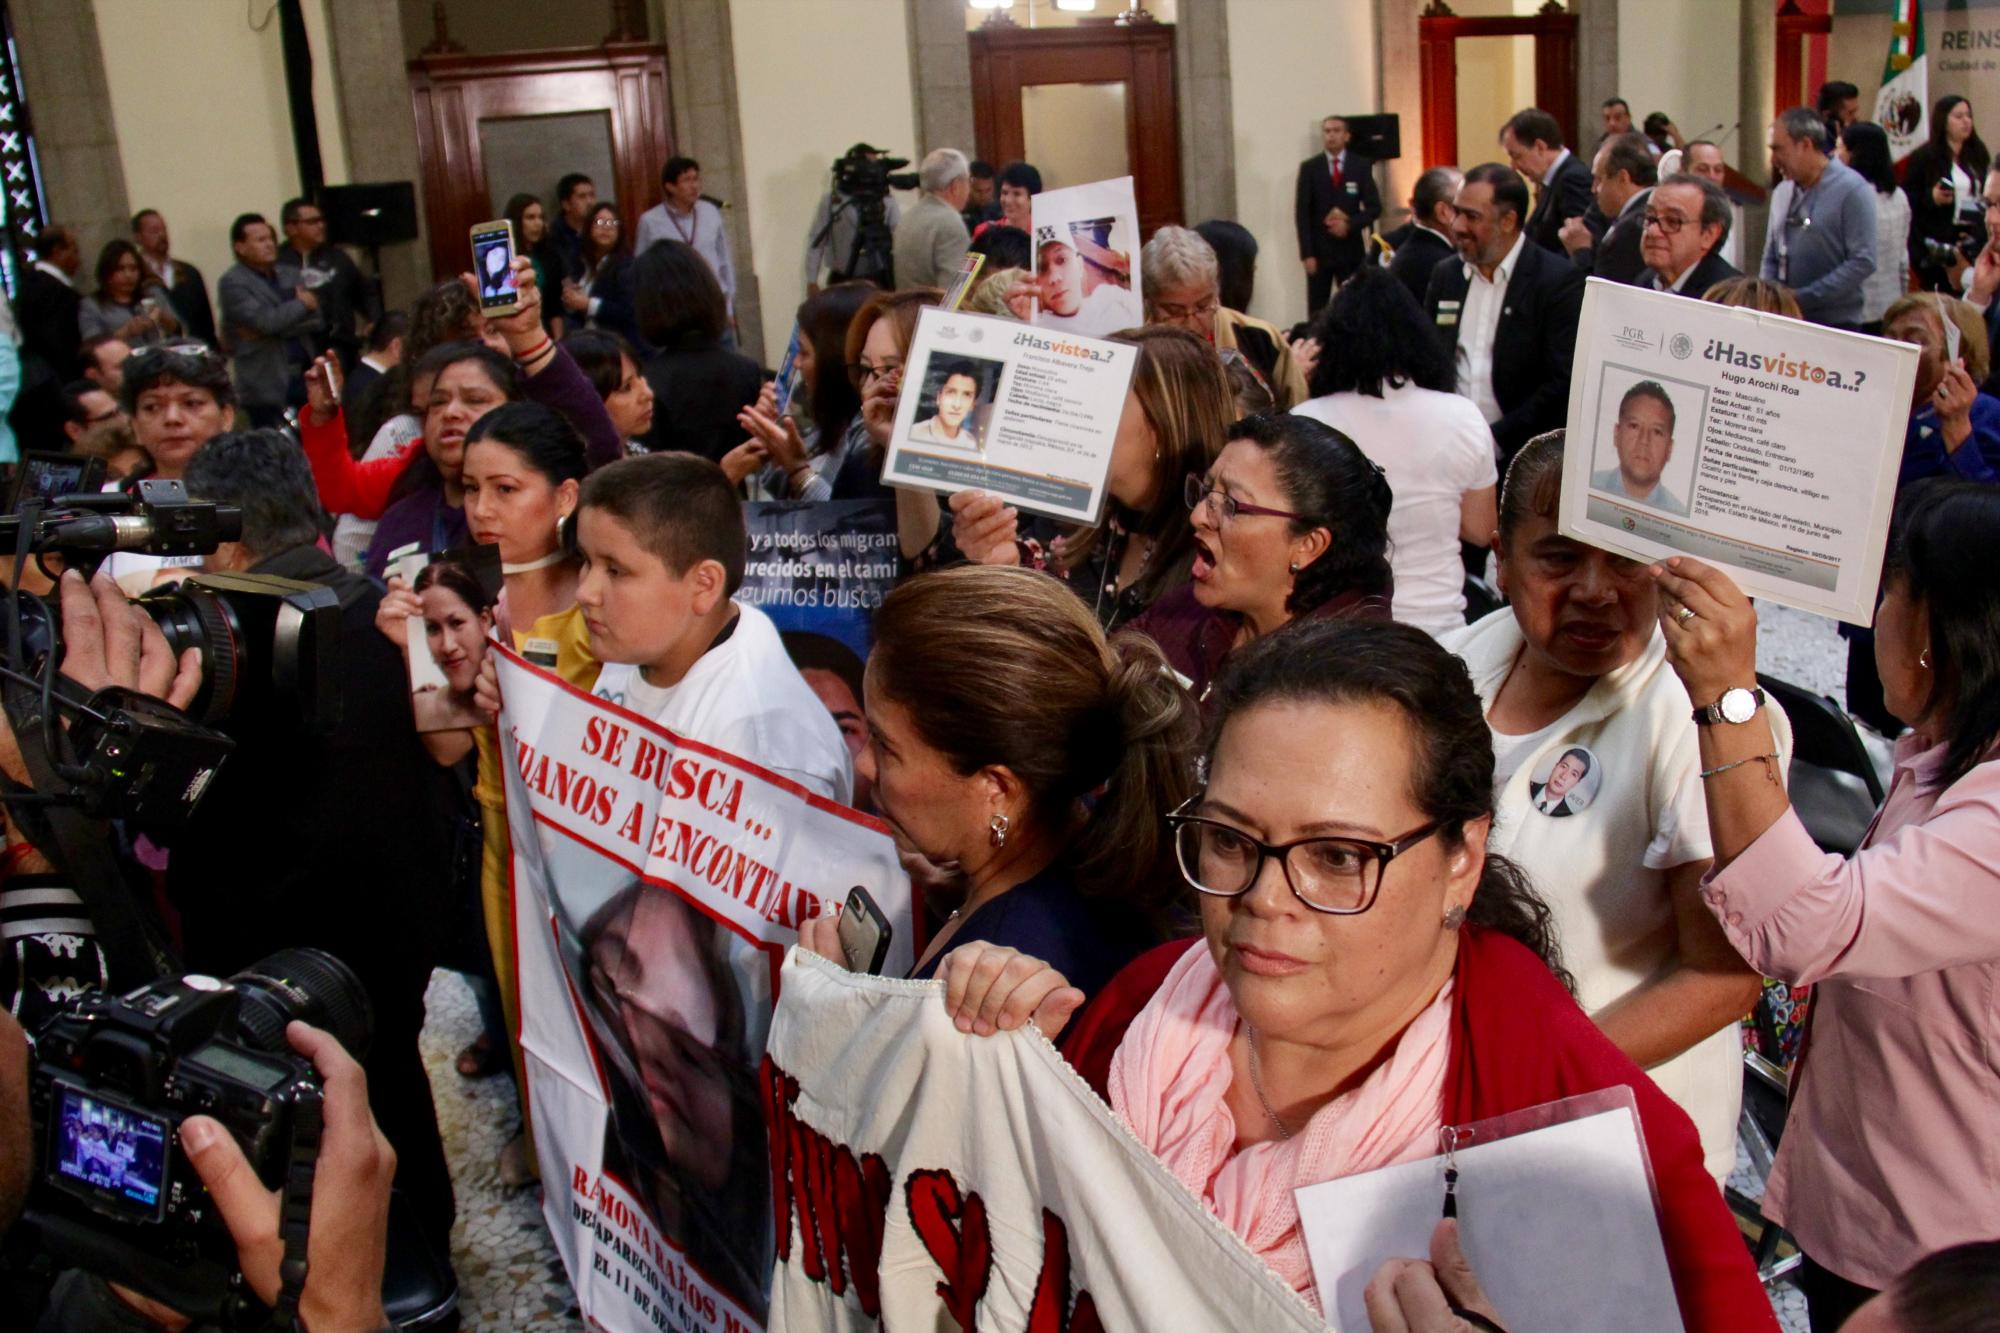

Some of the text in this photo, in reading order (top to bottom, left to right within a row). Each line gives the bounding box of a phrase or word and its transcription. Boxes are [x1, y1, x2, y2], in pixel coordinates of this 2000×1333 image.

[1938, 58, 1978, 71] Ciudad
[1622, 325, 1644, 341] PGR
[1722, 371, 1746, 385] Hugo
[1780, 386, 1800, 396] Roa
[1711, 397, 1728, 405] Edad
[1764, 410, 1780, 418] años
[750, 529, 896, 552] y a todos los migran
[815, 563, 834, 578] en
[838, 559, 852, 578] el
[854, 558, 898, 578] cami
[823, 581, 889, 608] busca
[581, 716, 629, 768] SE
[616, 801, 644, 845] A
[572, 1164, 652, 1256] RAMONA
[594, 1250, 610, 1279] EL
